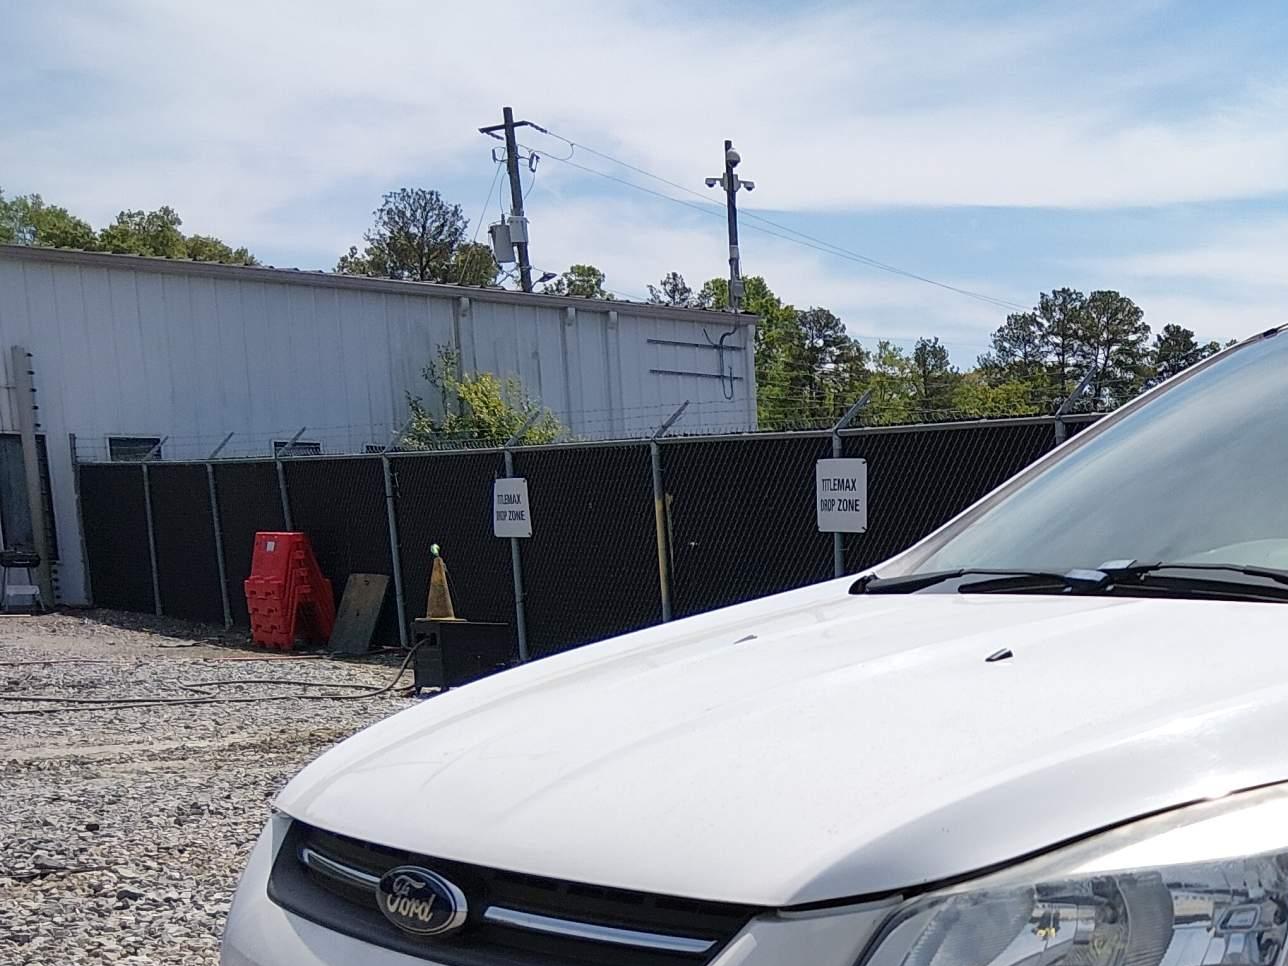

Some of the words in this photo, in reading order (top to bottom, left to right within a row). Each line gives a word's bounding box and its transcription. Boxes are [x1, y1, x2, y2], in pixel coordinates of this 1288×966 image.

[821, 478, 857, 492] TITLEMAX
[820, 498, 836, 512] DROP
[837, 498, 861, 512] ZONE
[508, 510, 527, 521] ZONE
[387, 875, 436, 922] Ford
